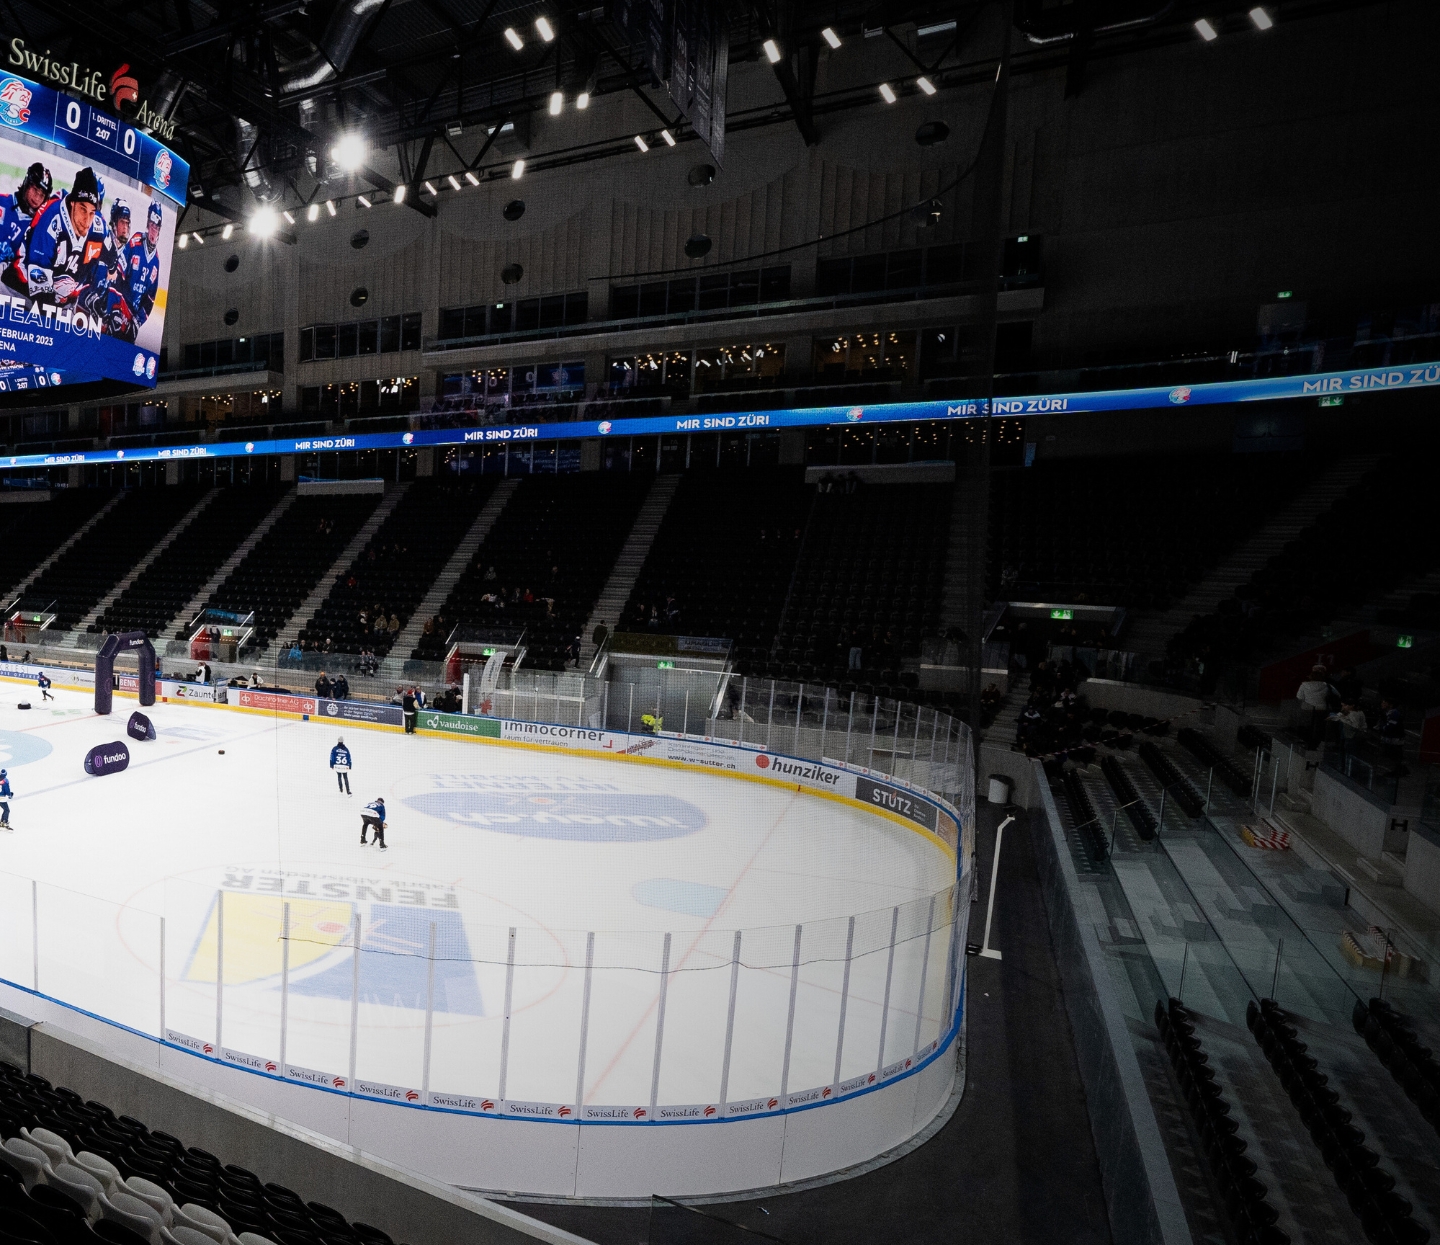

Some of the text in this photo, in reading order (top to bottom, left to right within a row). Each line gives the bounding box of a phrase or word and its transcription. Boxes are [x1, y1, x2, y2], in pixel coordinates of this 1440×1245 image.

[9, 37, 107, 100] SwissLife
[66, 101, 81, 130] 0
[136, 100, 176, 140] Arena
[96, 115, 117, 131] DRITTEL
[95, 127, 111, 140] 2:07
[124, 129, 136, 155] 0
[35, 334, 54, 347] 2023
[1303, 372, 1404, 393] MIR SIND
[947, 398, 1068, 416] MIR SIND ZÜRI
[676, 415, 770, 430] MIR SIND ZÜRI
[464, 428, 538, 442] MIR SIND ZÜRI
[295, 438, 355, 450] MIR SIND ZÜRI
[44, 454, 85, 465] MIR SIND ZÜRI
[158, 447, 207, 458] MIR SIND ZÜRI
[439, 719, 479, 732] vaudoise
[504, 721, 606, 742] immocorner
[103, 752, 127, 765] fundoo
[336, 756, 348, 765] 36
[668, 755, 736, 769] www.w-sutter.ch
[772, 758, 840, 785] hunziker
[221, 872, 460, 909] FENSTER
[168, 1032, 200, 1050] SwissLife
[225, 1052, 262, 1070] SwissLife
[289, 1068, 329, 1085] SwissLife
[359, 1083, 401, 1099] SwissLife
[841, 1079, 866, 1093] SwissLife
[433, 1095, 477, 1110] SwissLife
[788, 1093, 820, 1106] SwissLife
[509, 1103, 553, 1116] SwissLife
[586, 1107, 629, 1119] SwissLife
[660, 1107, 701, 1119] SwissLife
[729, 1102, 765, 1114] SwissLife
